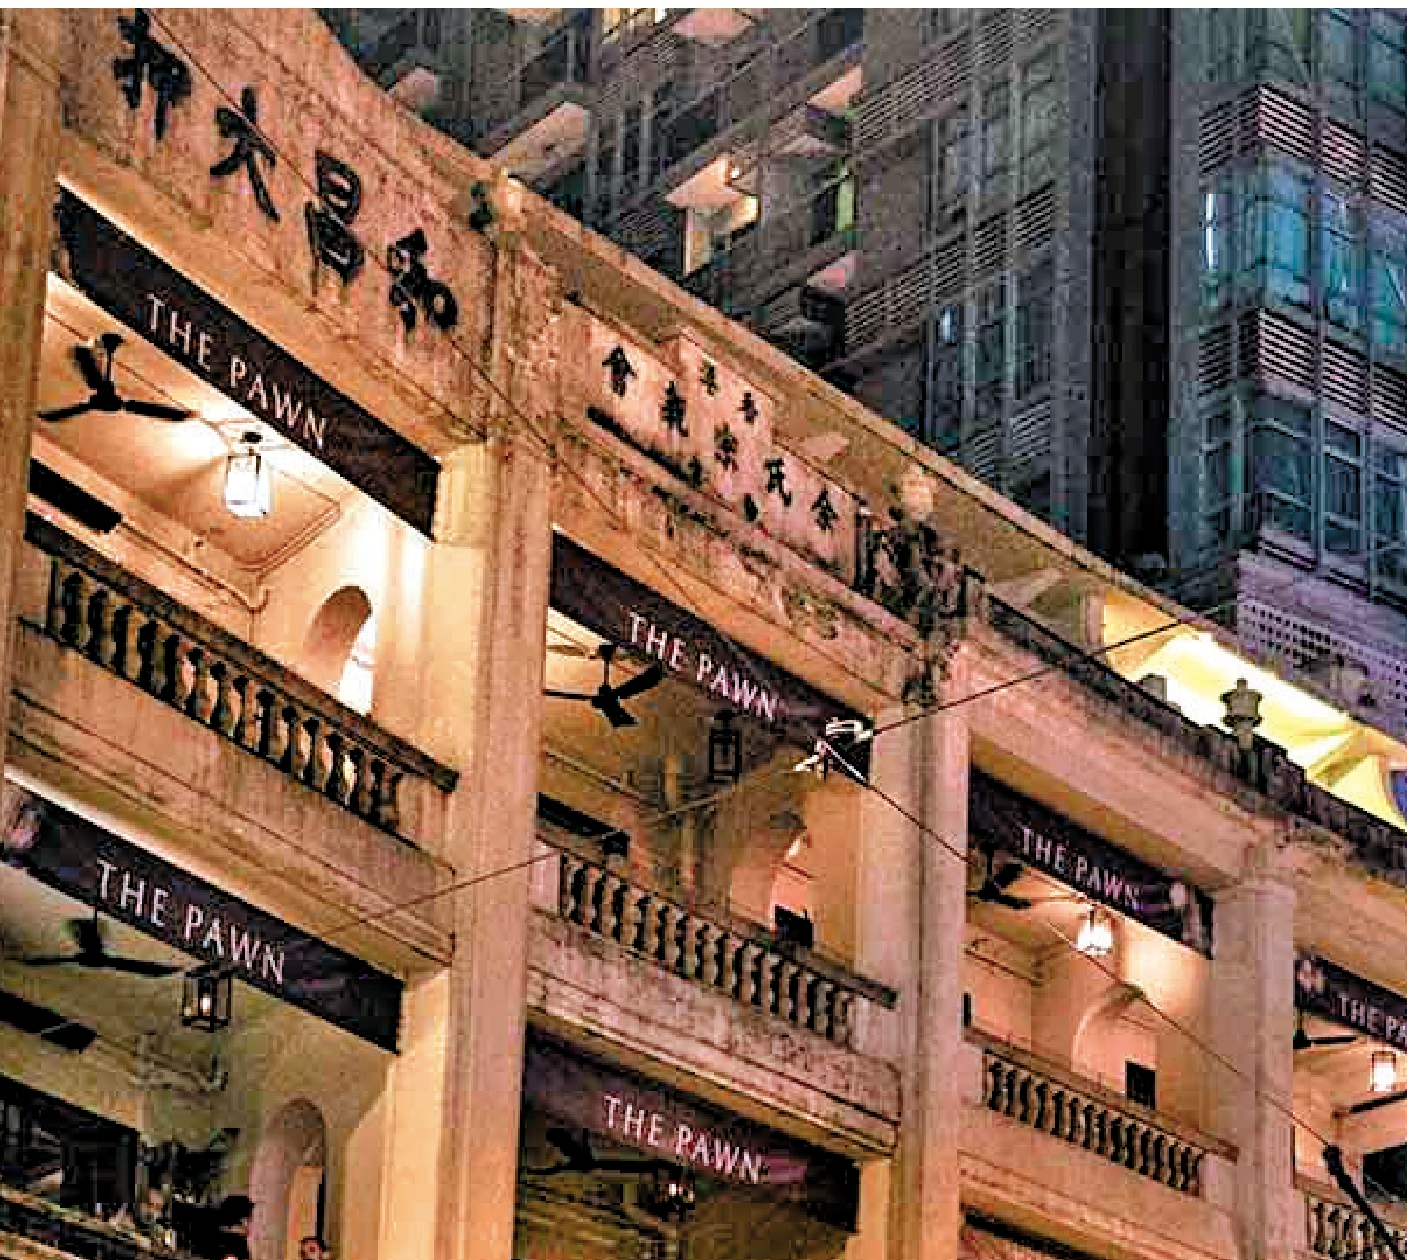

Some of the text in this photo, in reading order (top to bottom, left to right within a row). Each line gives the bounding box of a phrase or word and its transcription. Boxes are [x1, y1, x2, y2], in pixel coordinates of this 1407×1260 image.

[144, 290, 327, 449] THE PAWN
[628, 611, 779, 722] THE PAWN
[1020, 827, 1143, 910] THE PAWN
[96, 858, 284, 984] THE PAWN
[1336, 995, 1381, 1037] THE
[602, 1093, 765, 1183] THE PAWN
